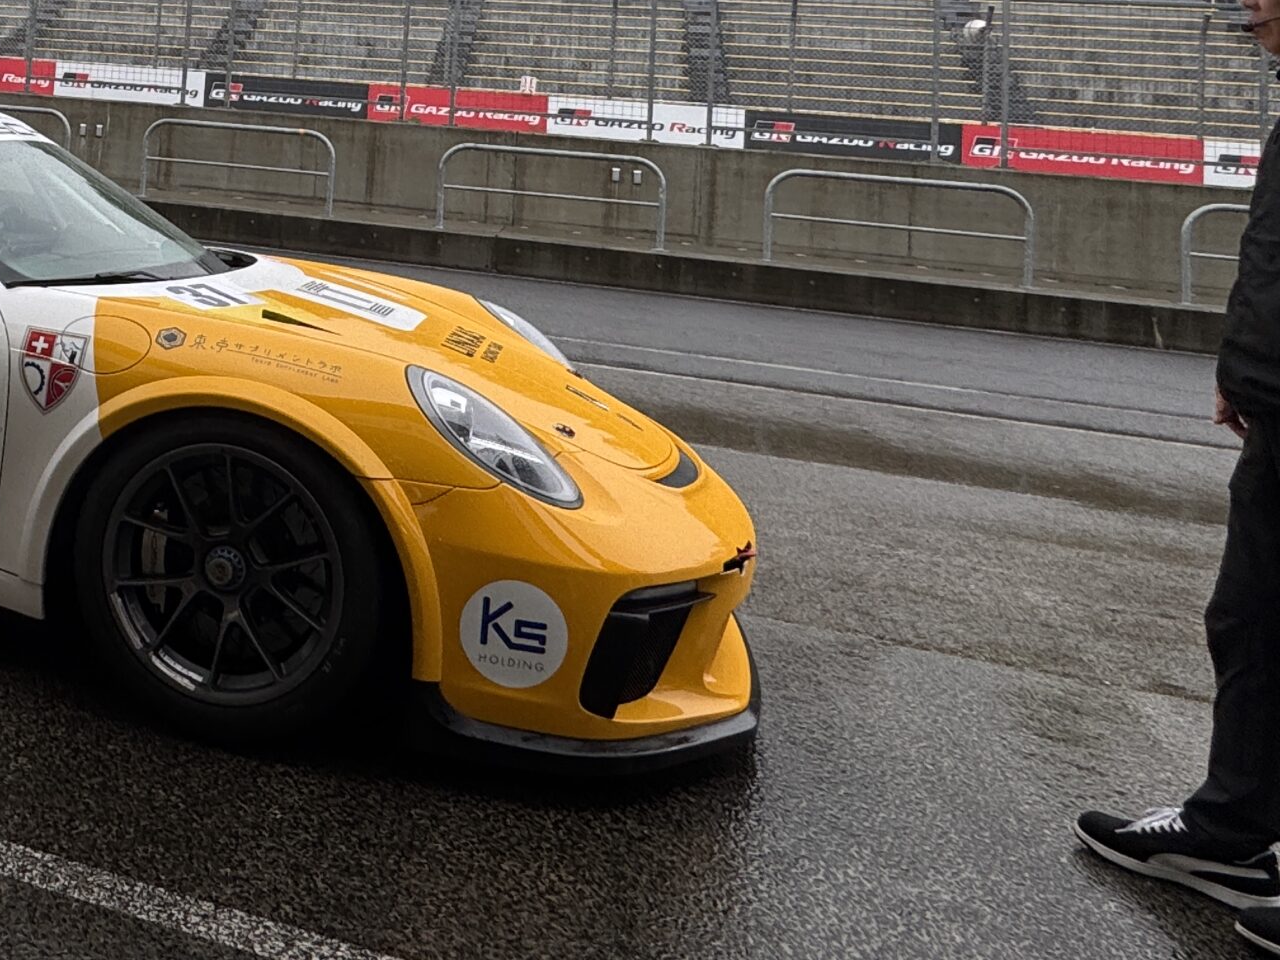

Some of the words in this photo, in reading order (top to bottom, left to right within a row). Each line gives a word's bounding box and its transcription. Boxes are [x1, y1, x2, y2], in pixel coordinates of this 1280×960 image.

[669, 121, 737, 140] Racng
[166, 284, 249, 308] 37
[478, 653, 545, 673] HOLDING
